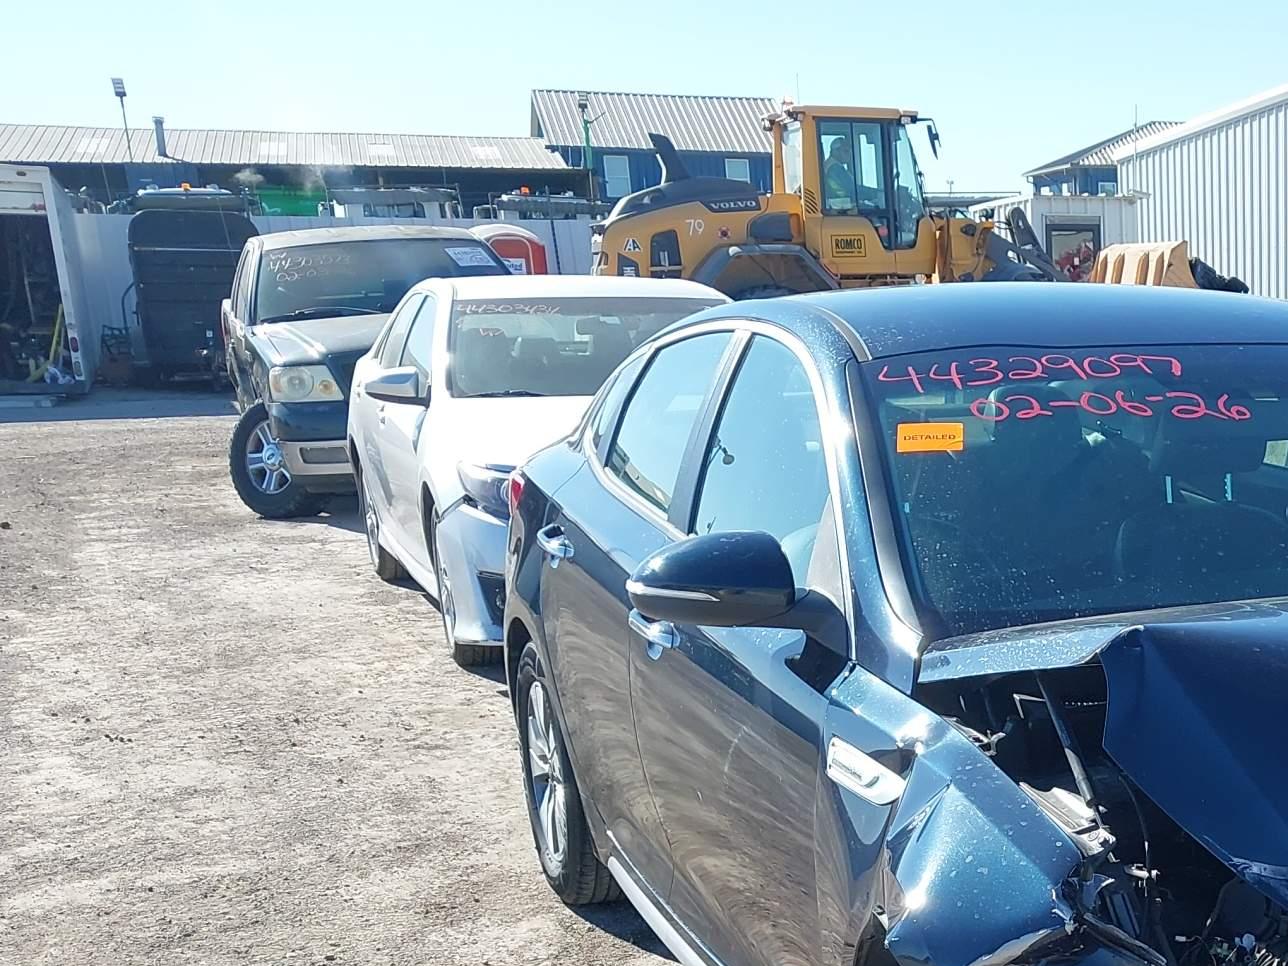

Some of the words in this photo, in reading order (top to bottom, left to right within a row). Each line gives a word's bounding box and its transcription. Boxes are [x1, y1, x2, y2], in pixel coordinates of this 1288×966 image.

[709, 200, 757, 209] VOLVO
[684, 219, 705, 236] 79
[835, 238, 862, 250] ROMCO
[878, 354, 1182, 393] 44329097
[969, 390, 1251, 420] 02-06-26
[903, 434, 956, 442] DETAILED
